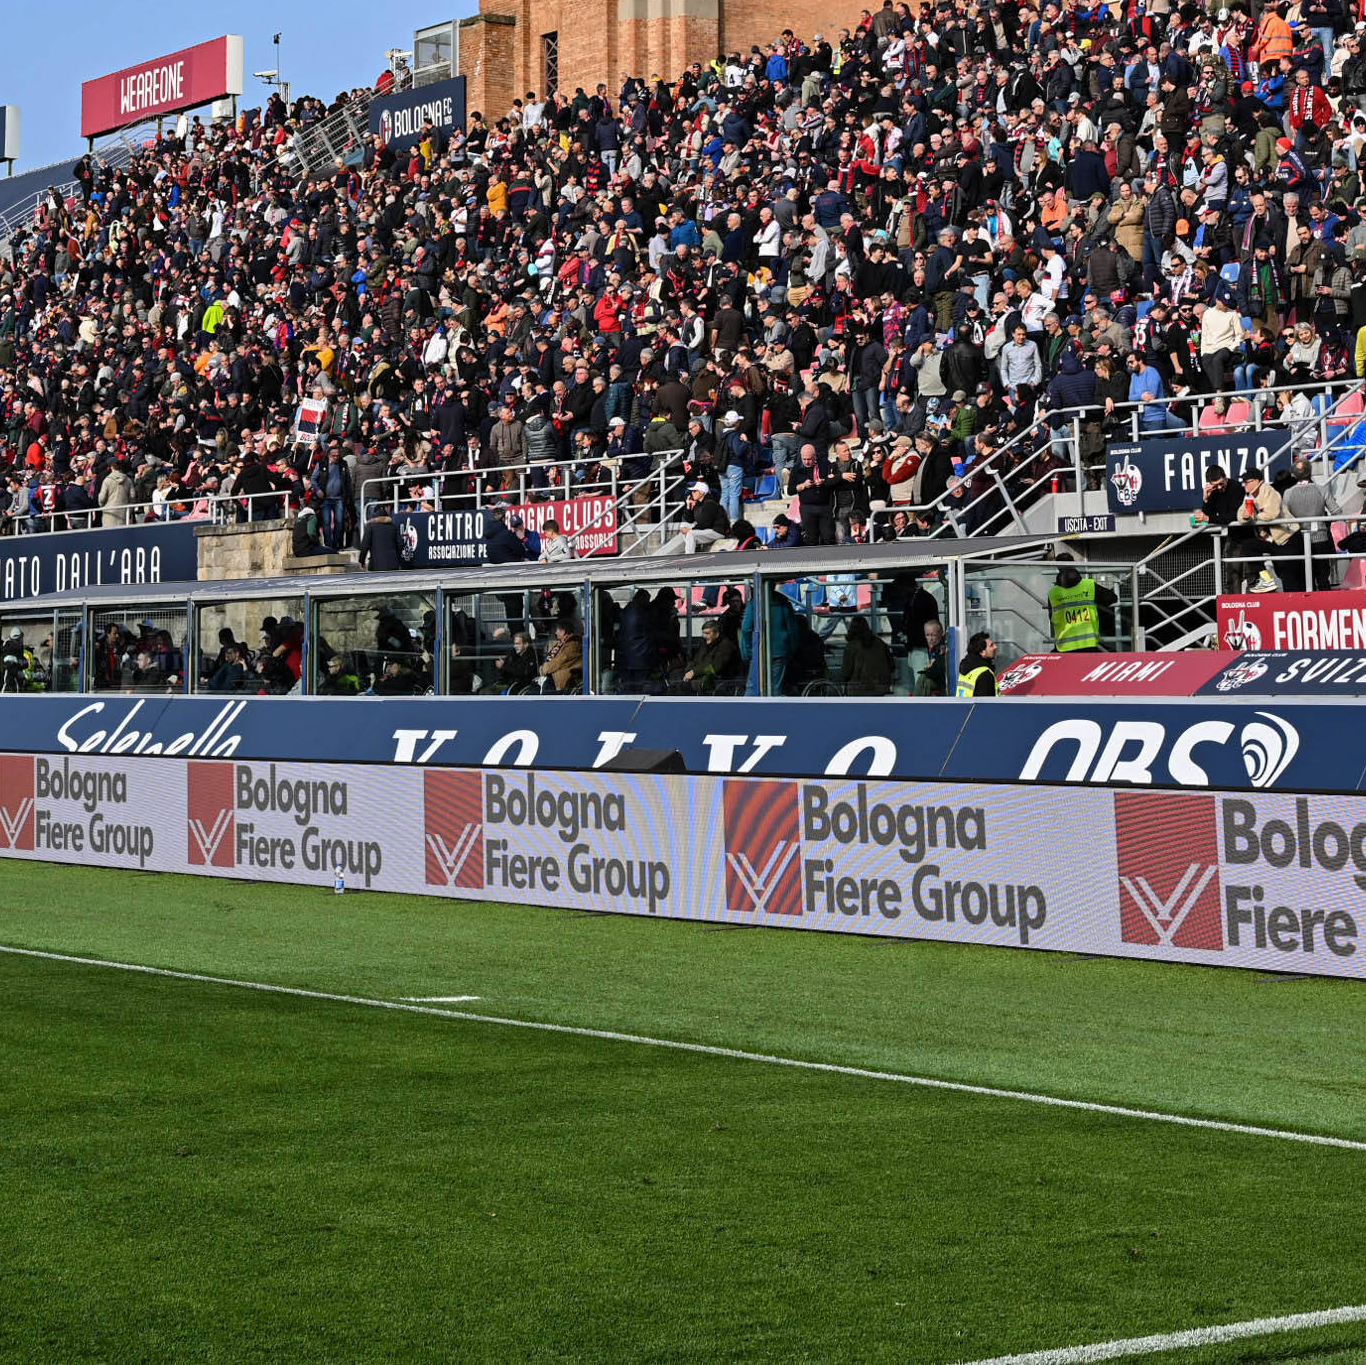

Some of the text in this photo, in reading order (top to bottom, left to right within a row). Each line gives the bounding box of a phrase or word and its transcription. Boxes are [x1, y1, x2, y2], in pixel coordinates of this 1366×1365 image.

[121, 61, 185, 114] WEAREONE
[395, 97, 453, 139] BOLOGNA FC
[445, 114, 453, 126] 1909
[1164, 446, 1270, 492] FAENZA
[44, 488, 53, 505] 2
[563, 499, 614, 532] CLUBS
[428, 513, 484, 542] CENTRO
[1065, 516, 1108, 533] USCITA EXIT
[56, 545, 161, 593] DALL'ARA
[1066, 607, 1091, 624] 0412
[1081, 660, 1176, 683] MIAMI
[36, 756, 127, 814] Bologna
[237, 763, 347, 827] Bologna
[485, 773, 625, 843] Bologna
[35, 815, 154, 868] Fiere Group
[802, 783, 987, 864] Bologna
[236, 827, 382, 887] Fiere Group
[485, 839, 670, 915] Fiere Group
[804, 857, 1047, 945] Fiere Group
[1225, 885, 1359, 960] Fiere
